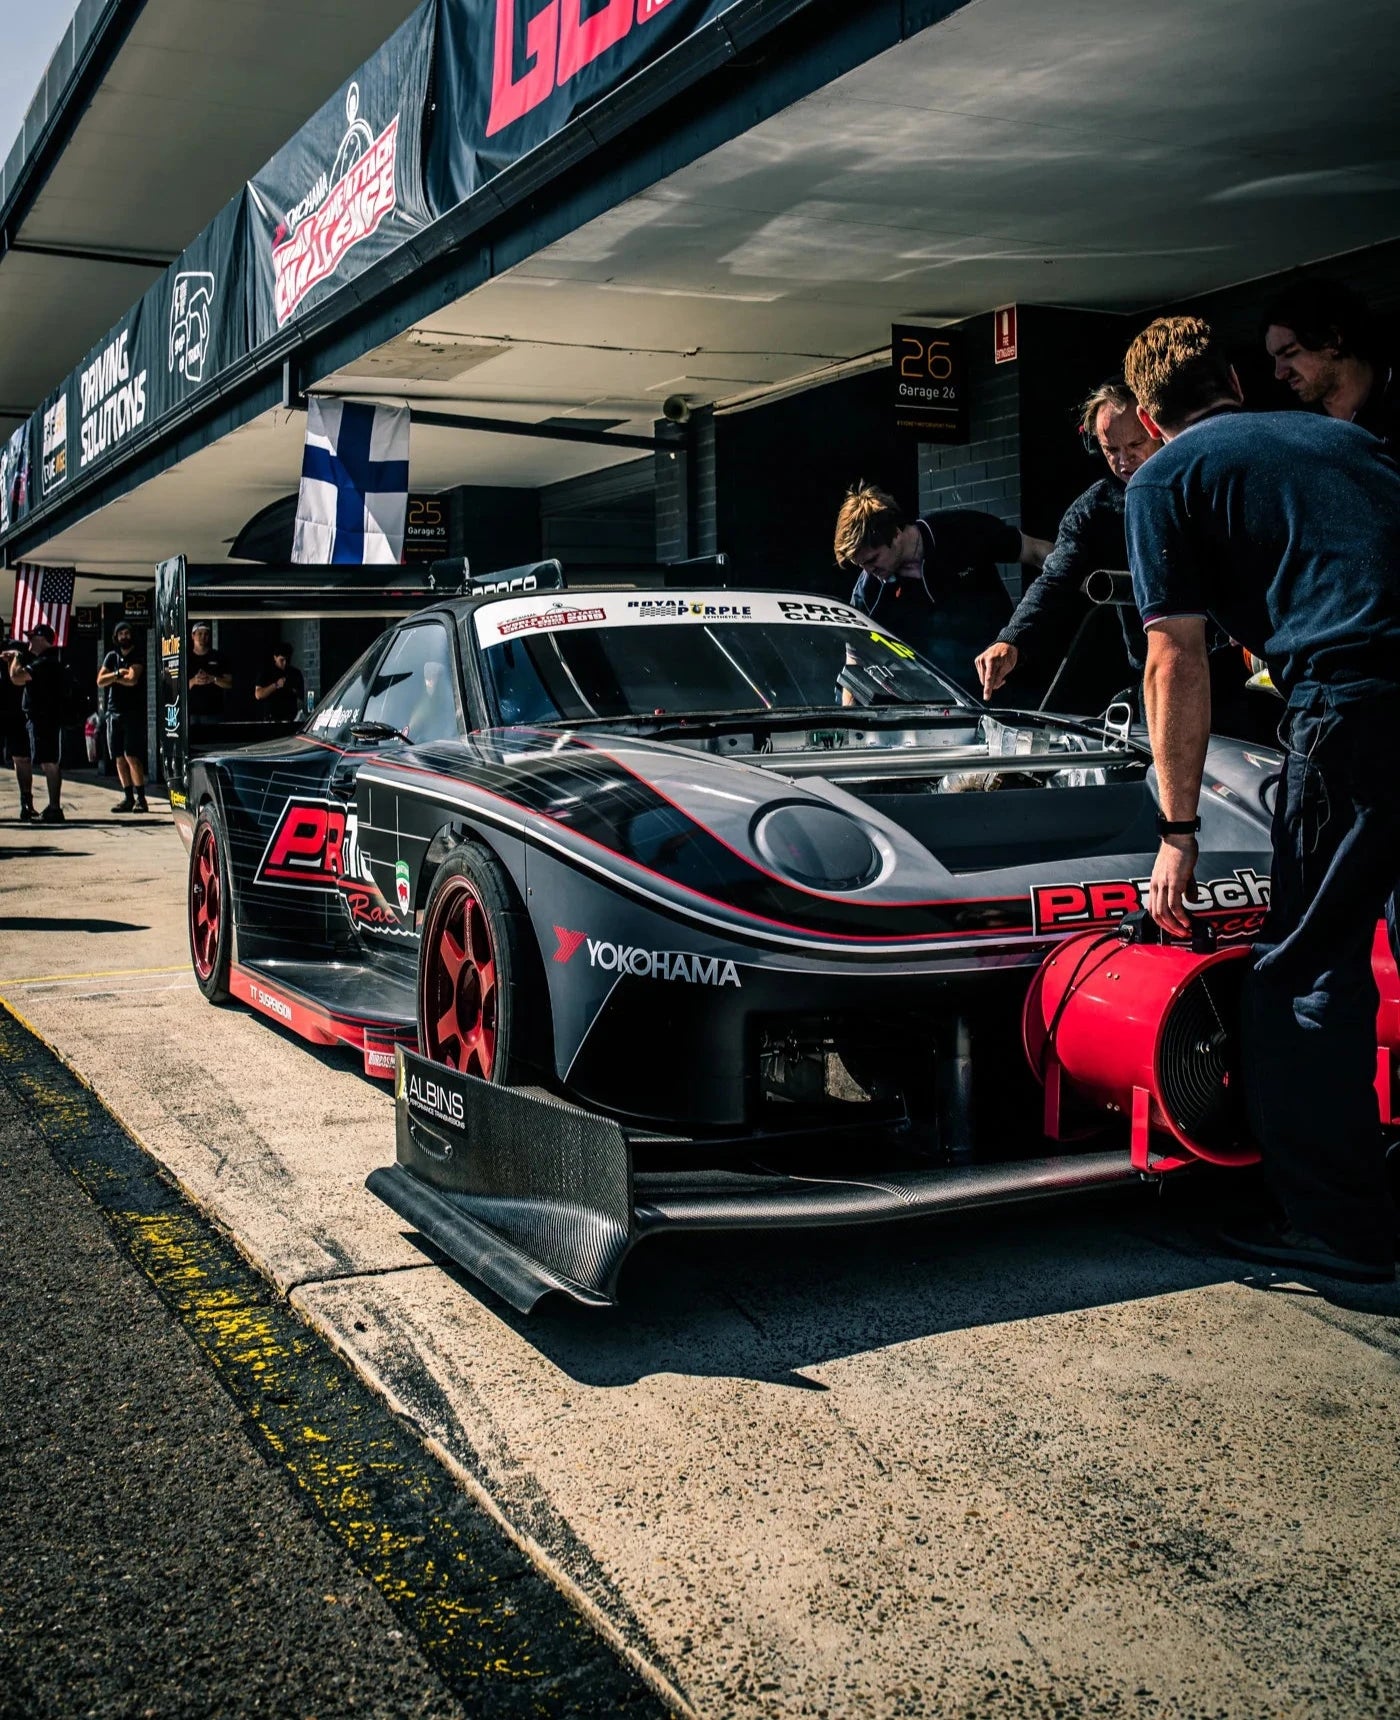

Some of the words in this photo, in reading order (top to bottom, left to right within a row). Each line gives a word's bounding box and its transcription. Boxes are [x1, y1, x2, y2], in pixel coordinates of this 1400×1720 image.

[276, 164, 394, 315] CHALLENGE
[80, 328, 129, 418] DRIVING
[901, 338, 952, 379] 26
[899, 383, 939, 400] Garage
[942, 386, 956, 399] 26
[80, 369, 147, 468] SOLUTIONS
[409, 501, 442, 525] 25
[407, 527, 435, 536] Garage
[436, 527, 446, 536] 25
[125, 594, 146, 609] 22
[627, 600, 686, 608] ROYAL
[777, 601, 858, 619] PRO
[784, 612, 869, 628] CLASS
[586, 937, 742, 988] YOKOHAMA
[249, 984, 258, 1000] TT
[258, 989, 293, 1021] SUSPENSION
[409, 1073, 464, 1120] ALBINS
